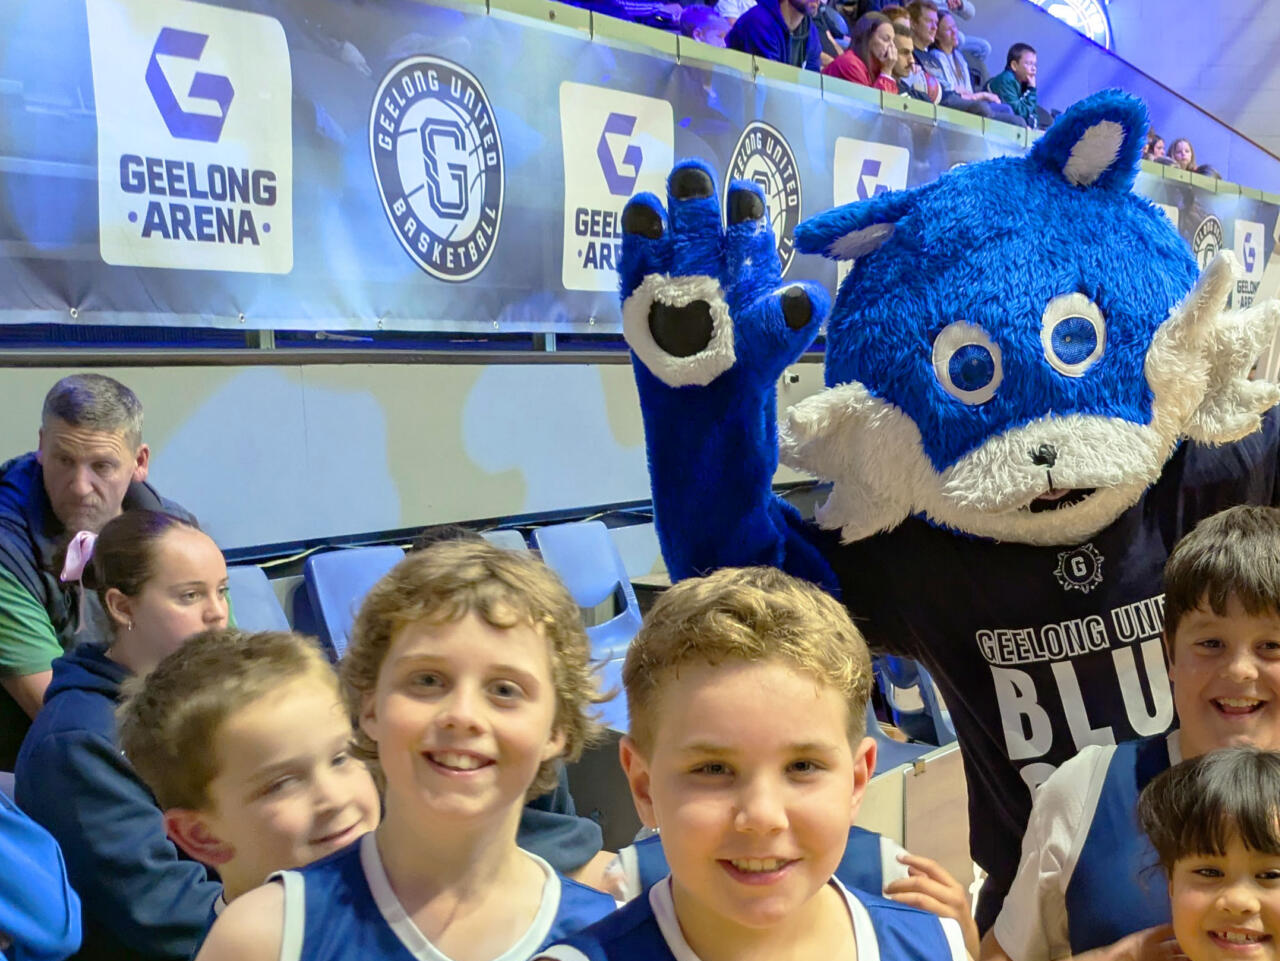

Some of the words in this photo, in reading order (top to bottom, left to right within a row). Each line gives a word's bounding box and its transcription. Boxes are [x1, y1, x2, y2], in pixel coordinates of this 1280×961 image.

[378, 70, 439, 151] GEELONG
[451, 75, 498, 166] UNITED
[119, 153, 277, 207] GEELONG
[420, 117, 469, 221] G
[733, 132, 762, 181] EELONG
[766, 136, 798, 206] UNITED
[141, 200, 260, 246] ARENA
[393, 197, 496, 269] BASKETBALL
[575, 207, 623, 239] GEEL
[1071, 556, 1087, 577] G
[975, 615, 1110, 665] GEELONG
